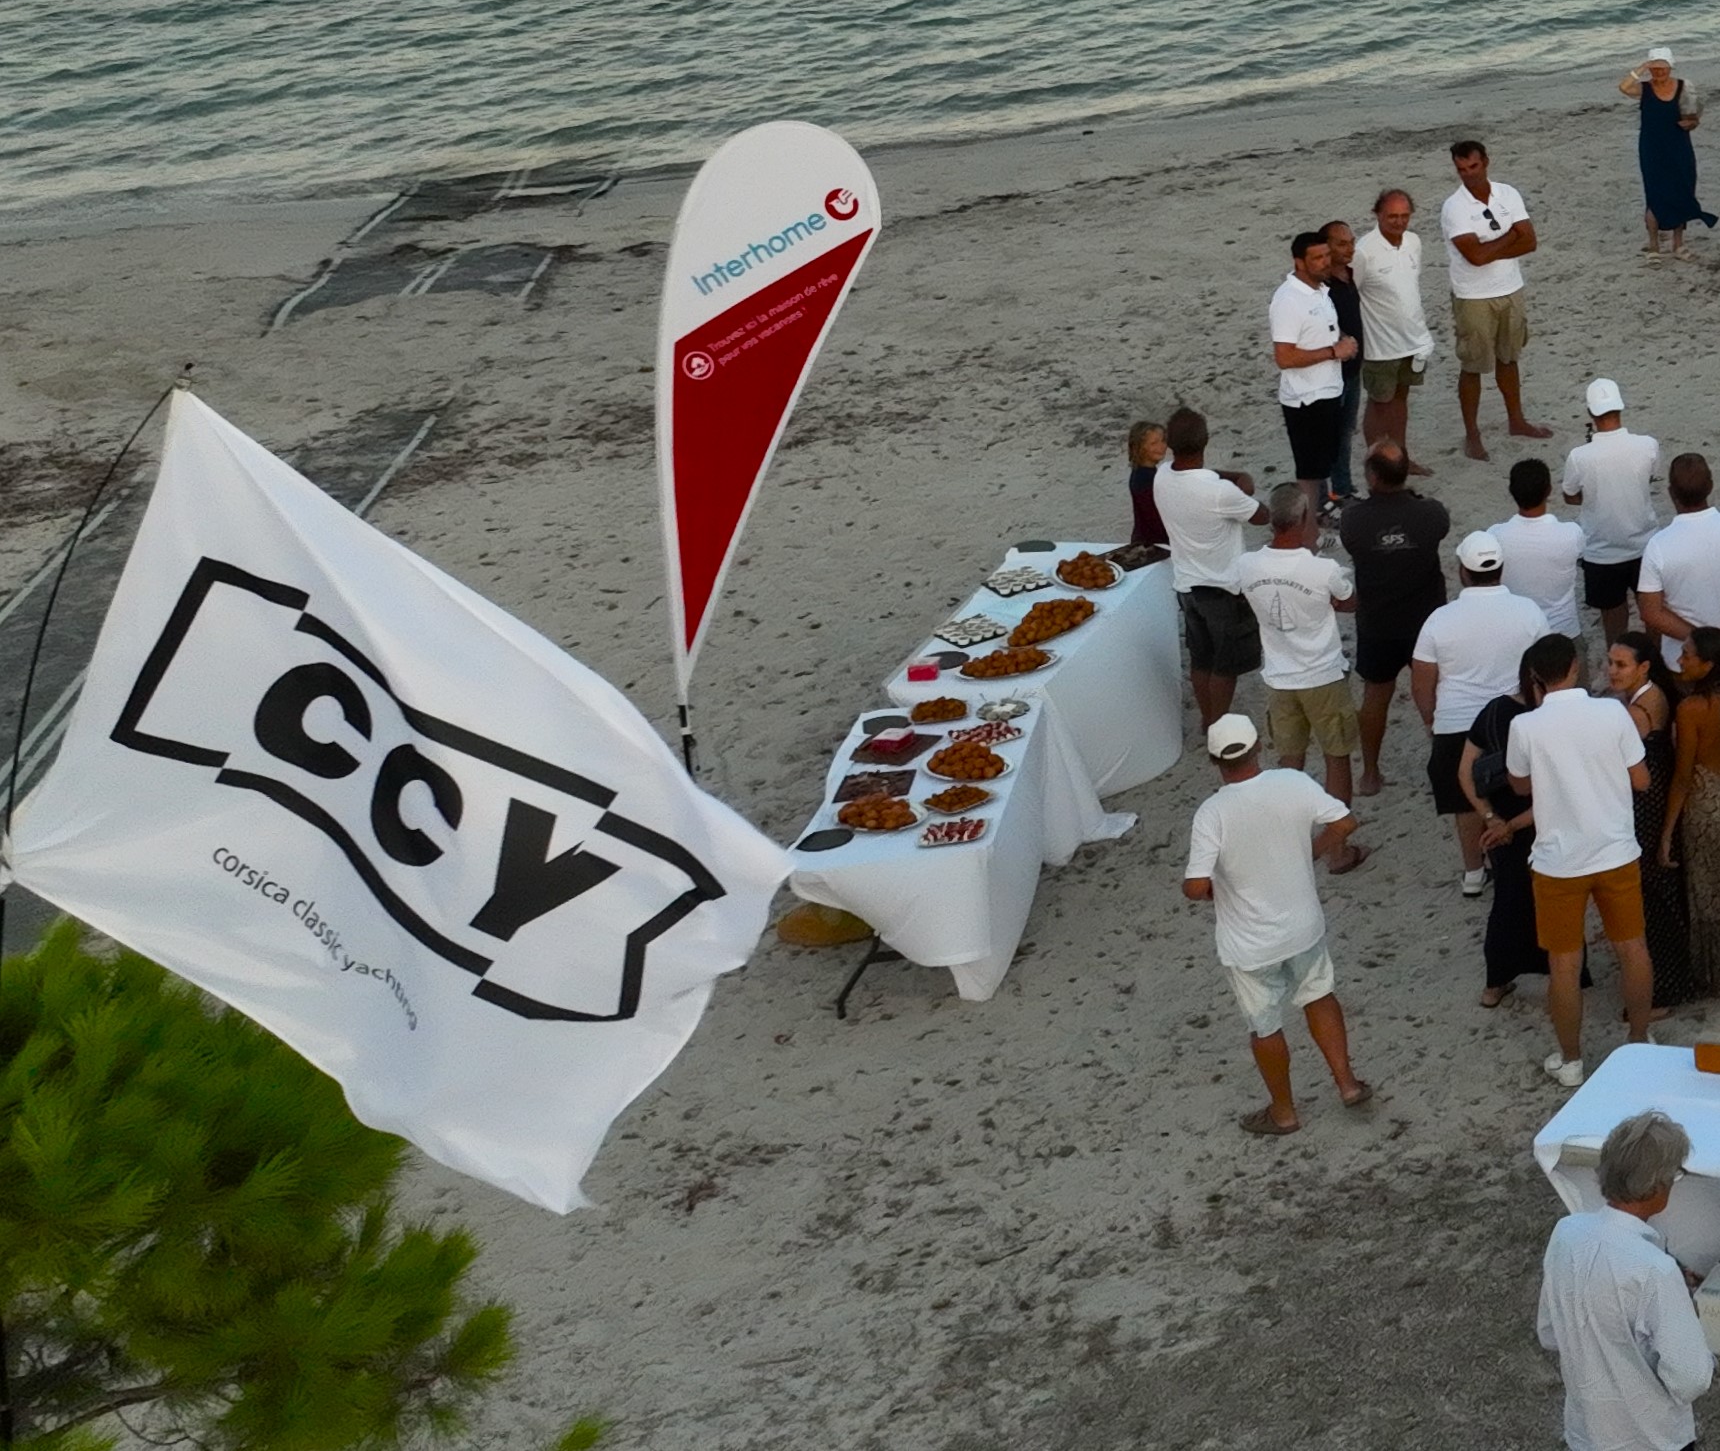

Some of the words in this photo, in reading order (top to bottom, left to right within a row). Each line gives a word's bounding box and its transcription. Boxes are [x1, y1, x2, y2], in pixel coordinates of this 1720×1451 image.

[690, 212, 828, 297] Interhome
[253, 661, 623, 942] CCY
[212, 847, 291, 905] corsica
